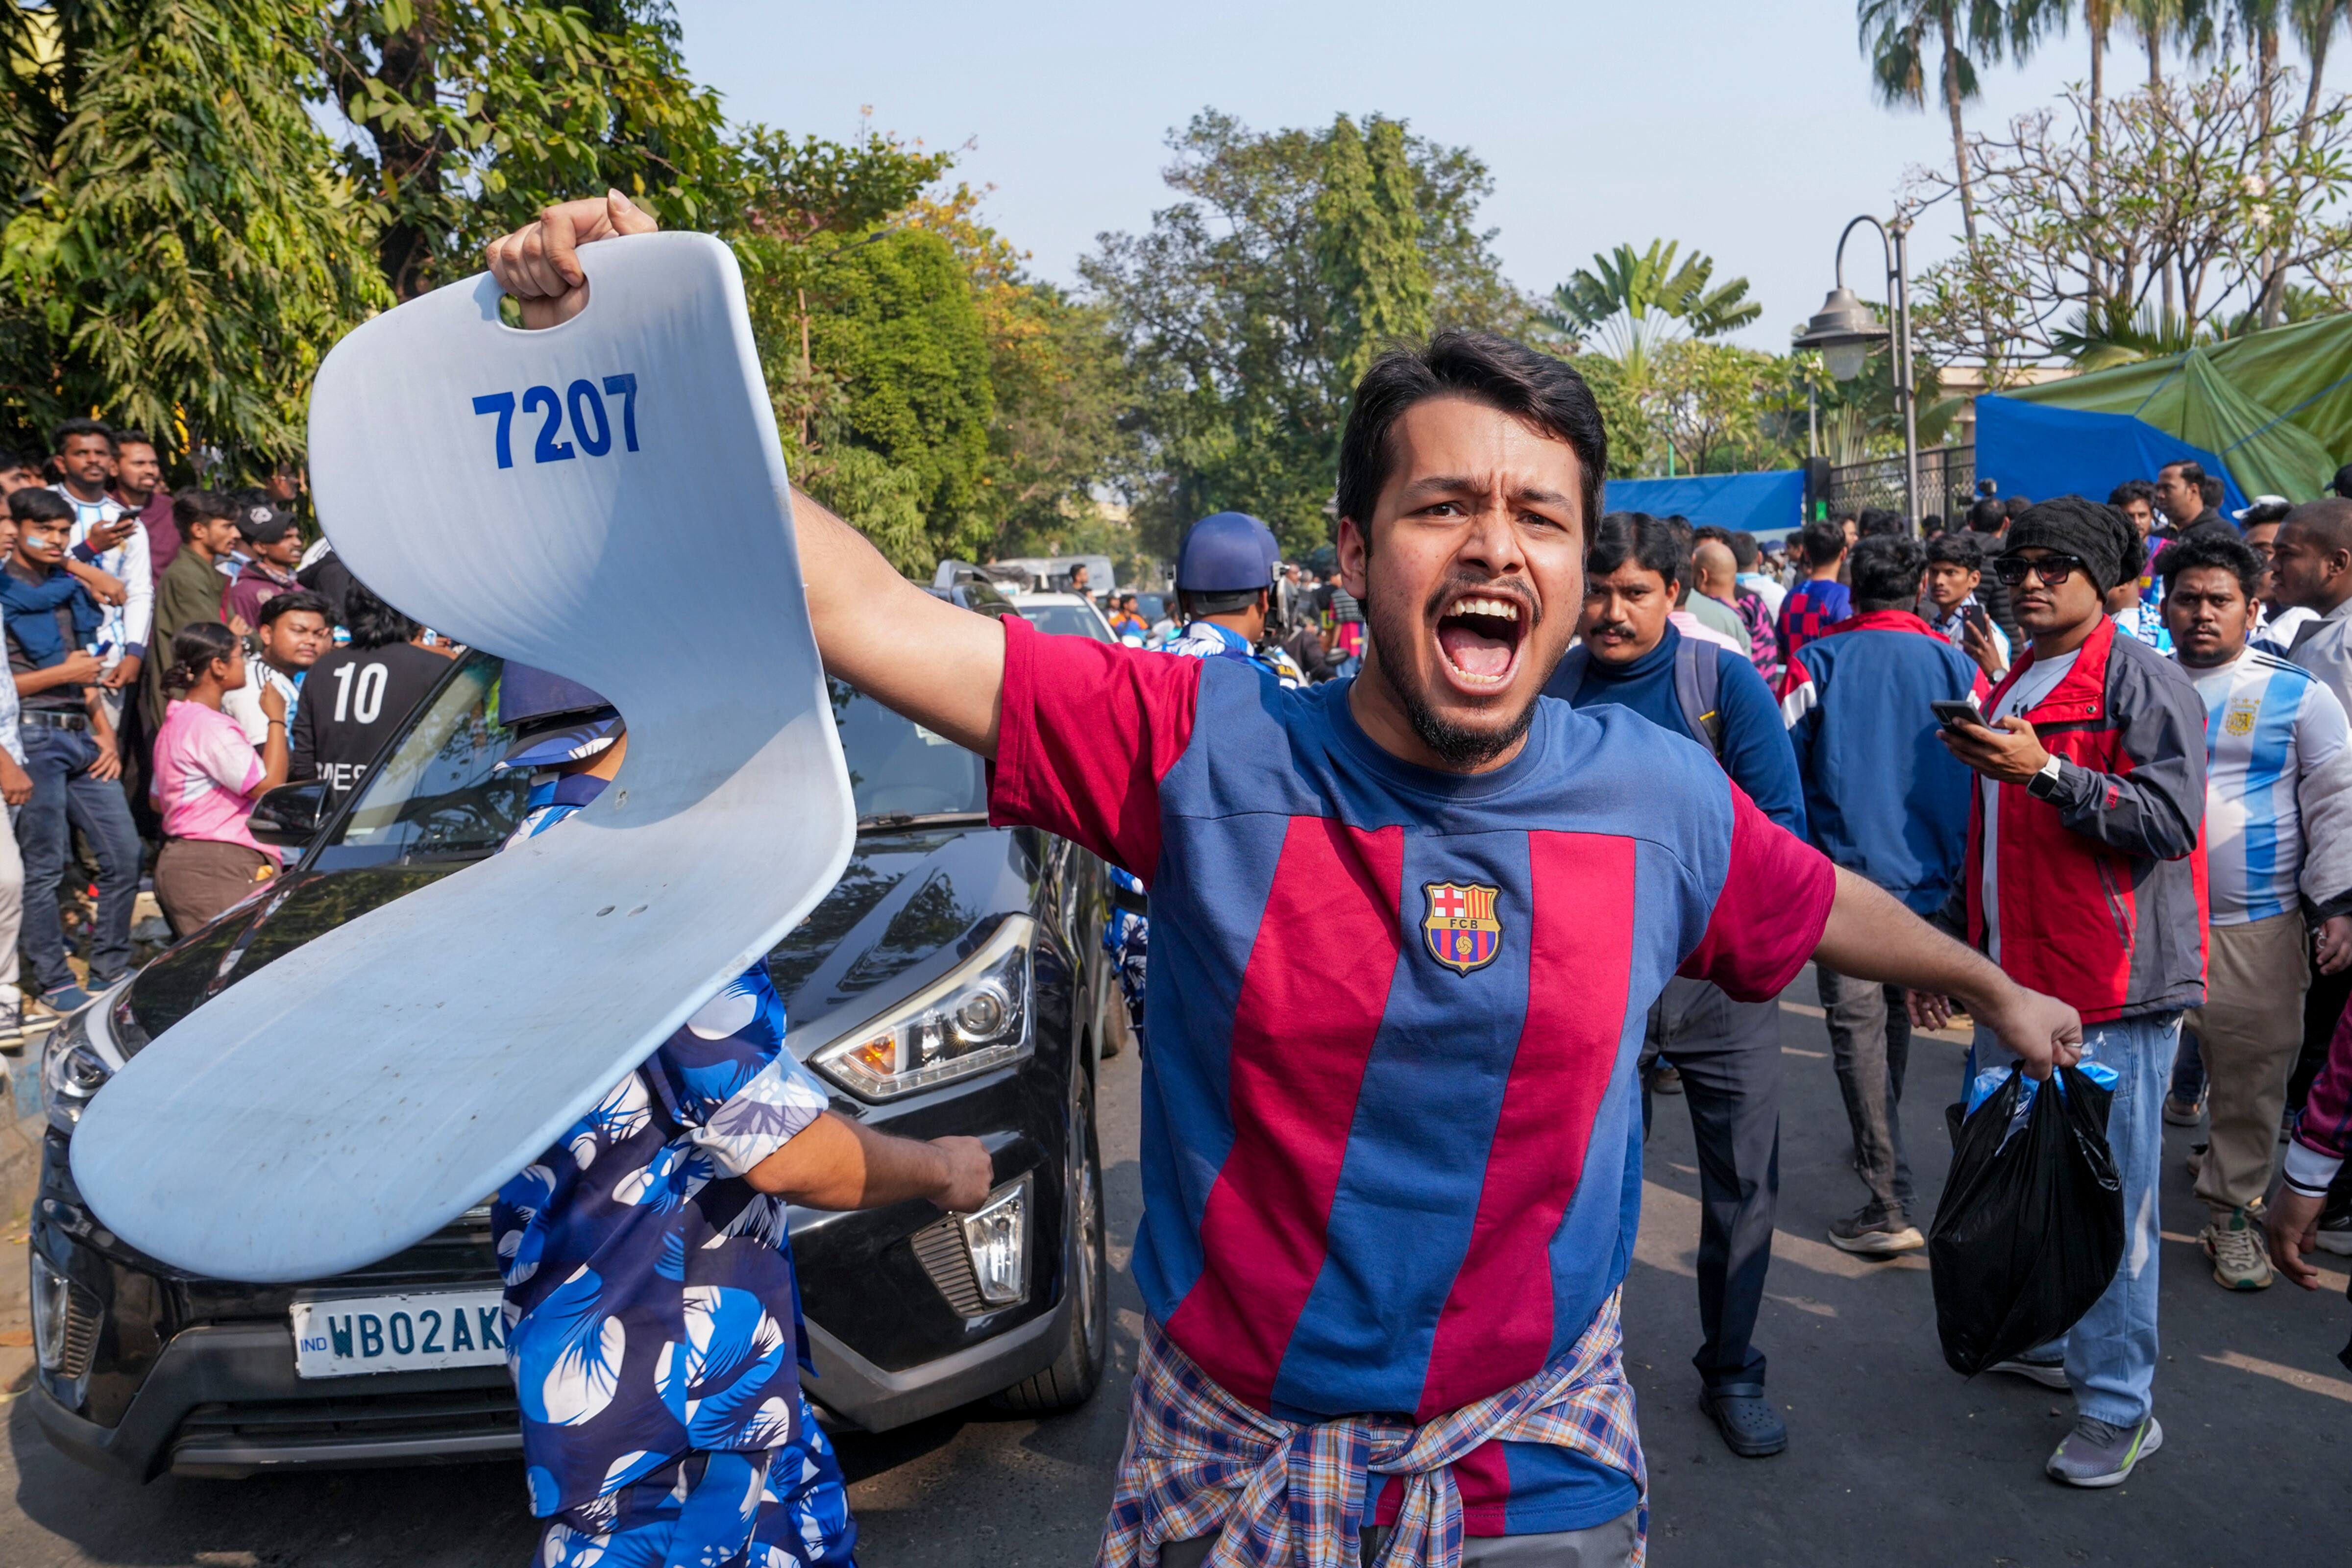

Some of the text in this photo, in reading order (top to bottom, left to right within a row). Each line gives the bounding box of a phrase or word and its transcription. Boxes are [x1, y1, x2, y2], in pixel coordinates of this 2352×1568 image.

[472, 373, 639, 469] 7207
[333, 662, 388, 724] 10
[1450, 919, 1478, 929] FCB
[300, 1306, 504, 1358] IND WB02AK
